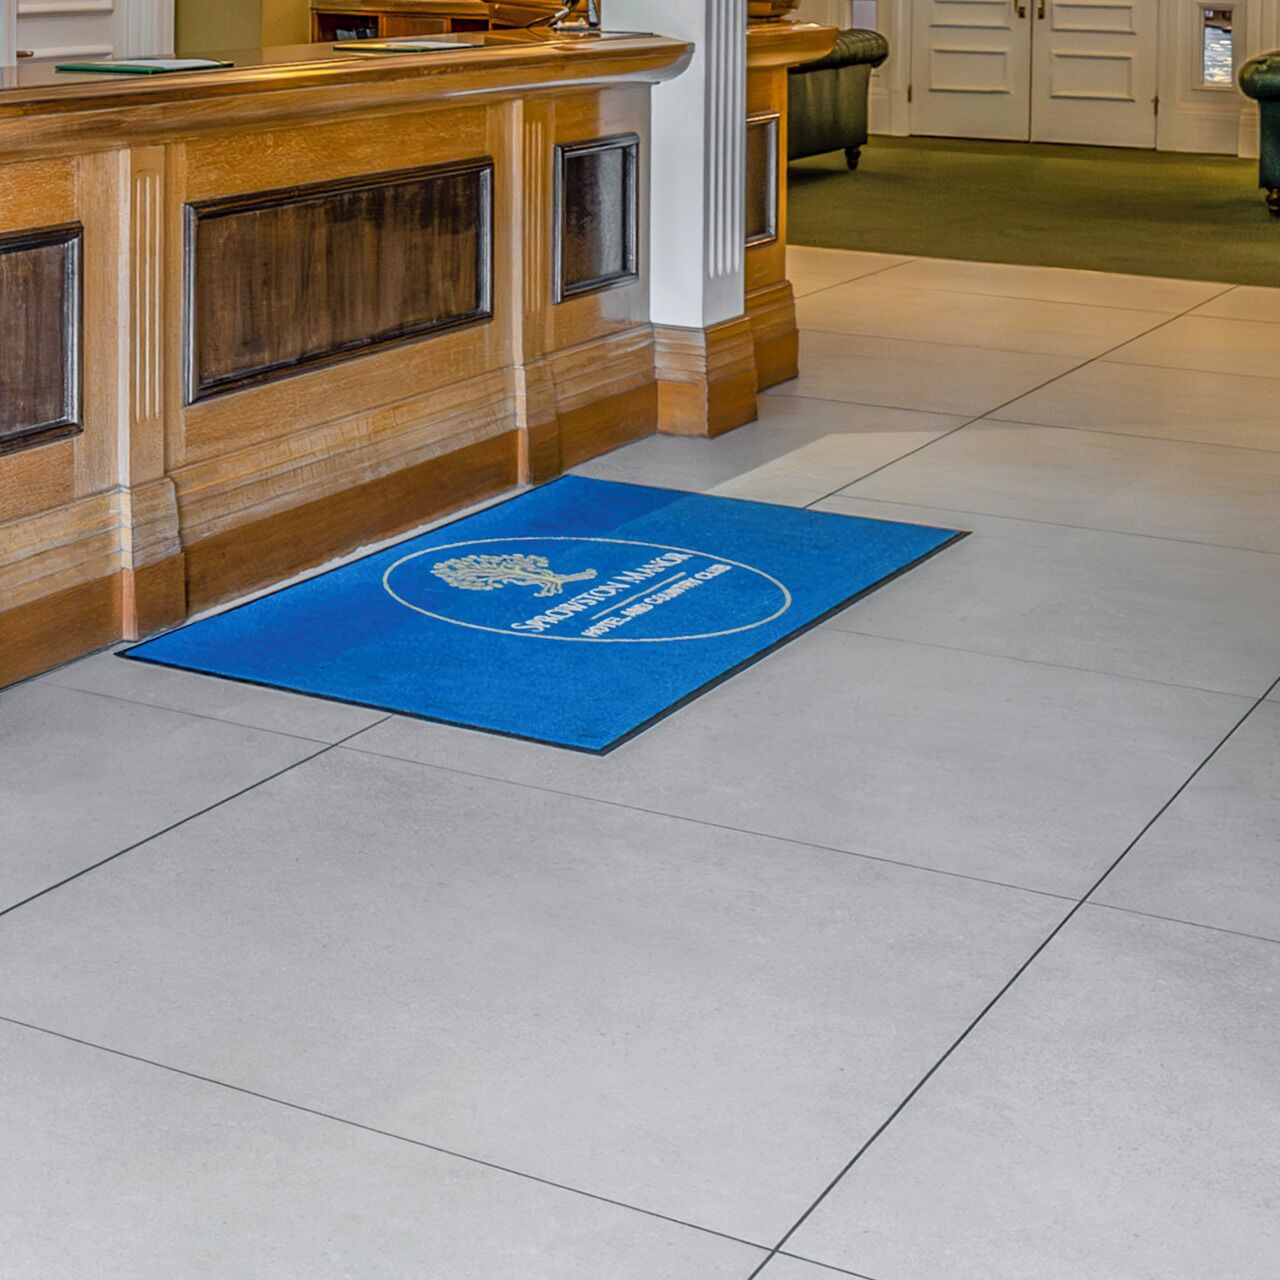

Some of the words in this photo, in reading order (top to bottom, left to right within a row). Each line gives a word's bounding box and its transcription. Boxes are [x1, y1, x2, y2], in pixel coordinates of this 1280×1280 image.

[511, 581, 631, 632] SPROWSTON
[611, 553, 694, 584] MANOR
[581, 617, 633, 637] HOTEL
[620, 603, 655, 618] AND
[643, 577, 704, 605] COUNTRY
[693, 564, 733, 580] CLUB
